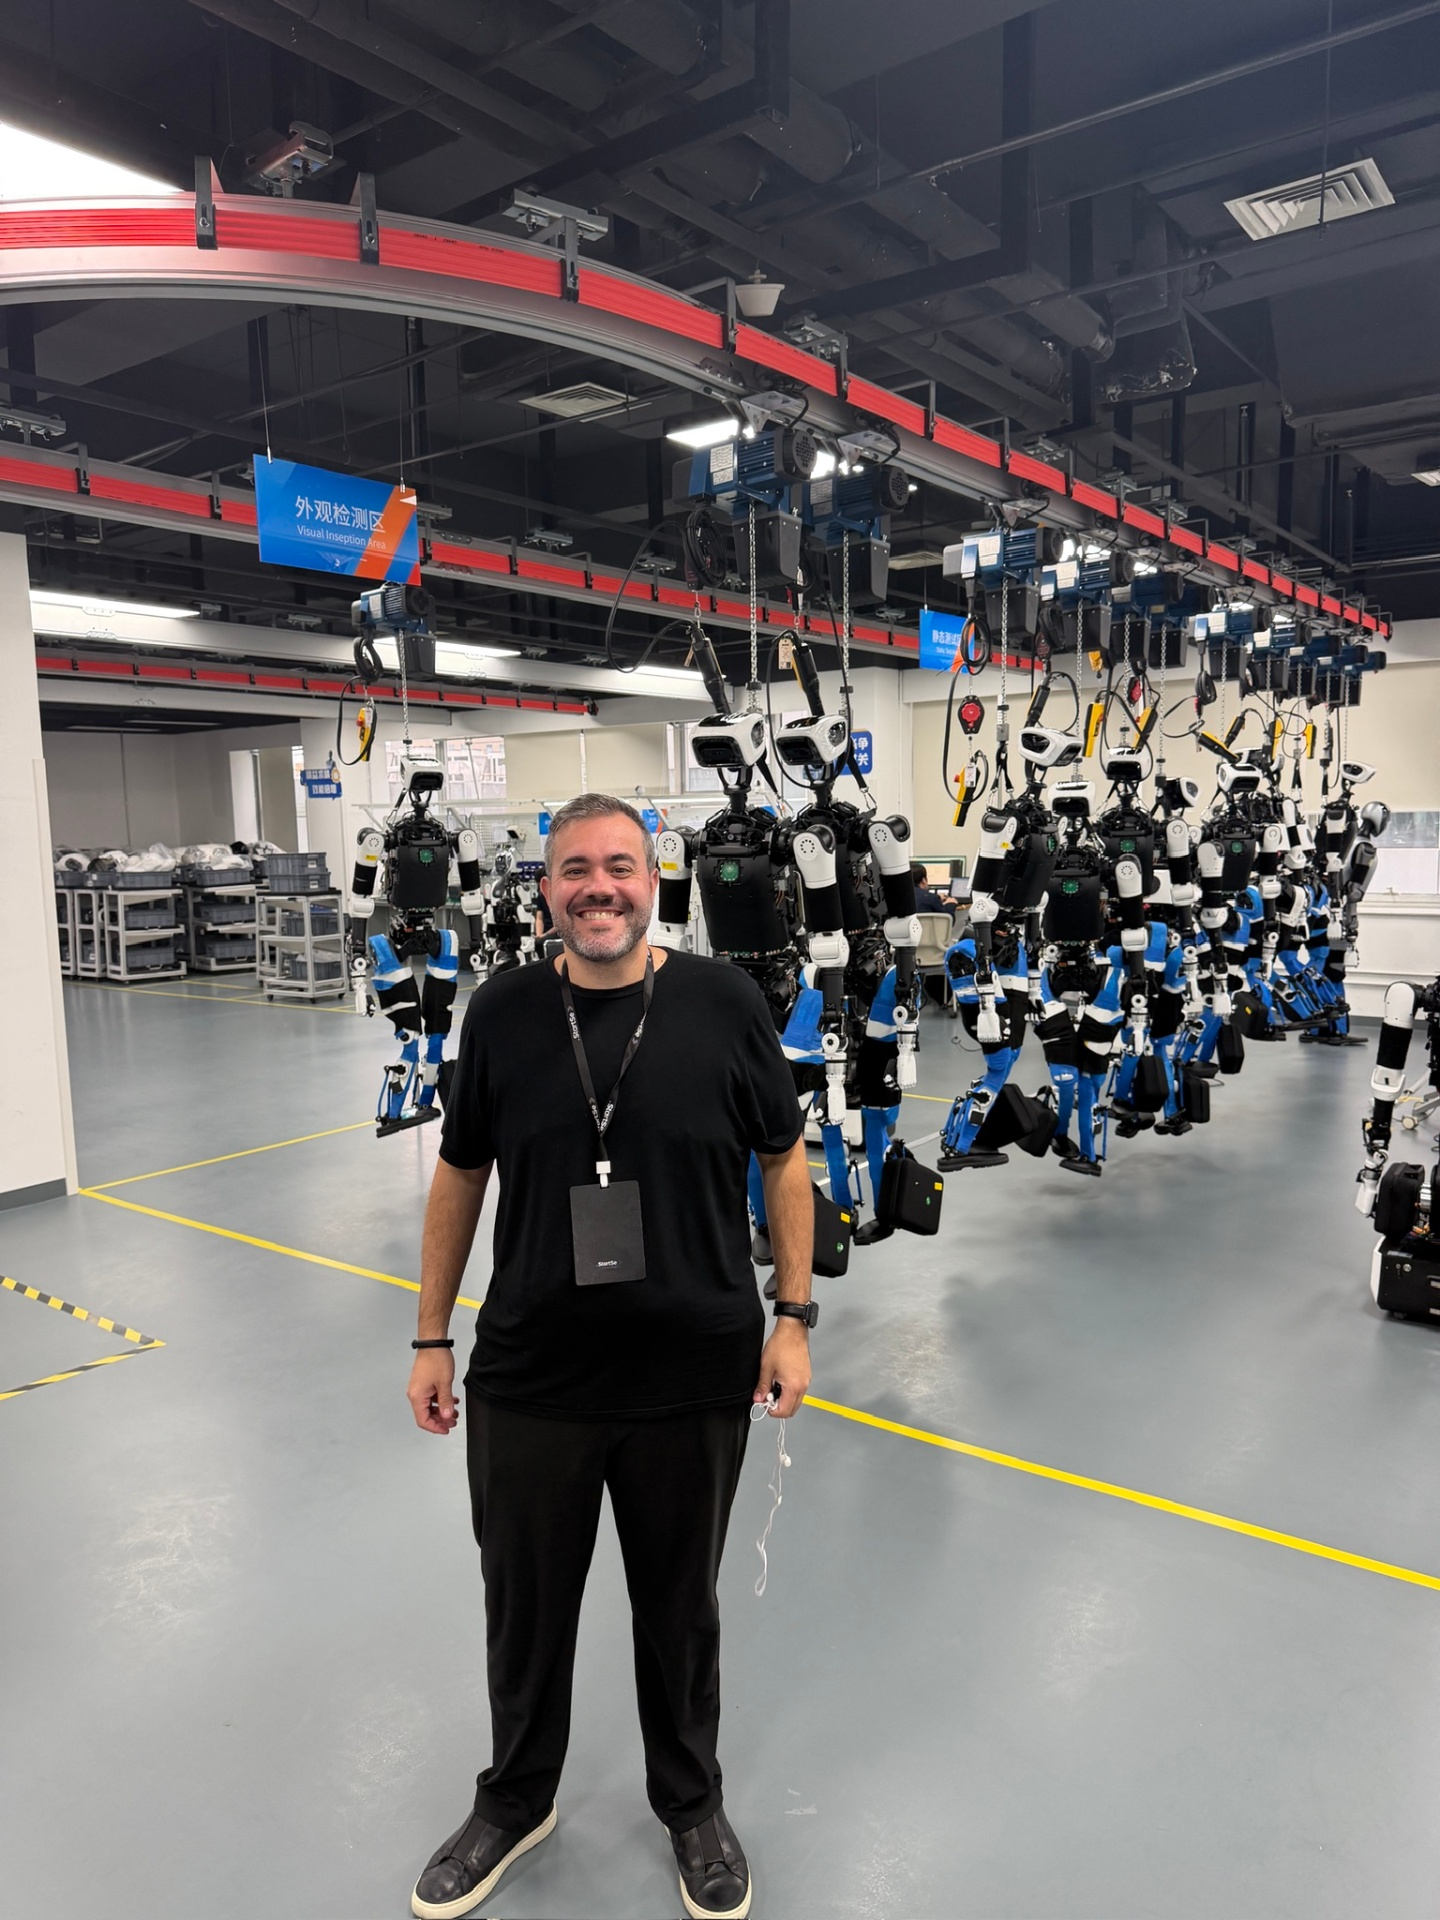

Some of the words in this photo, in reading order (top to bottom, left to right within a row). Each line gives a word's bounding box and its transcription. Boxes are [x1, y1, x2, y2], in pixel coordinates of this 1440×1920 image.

[295, 495, 386, 533] 外观检测区
[297, 525, 325, 539] Visual
[326, 530, 366, 546] Inseption
[367, 538, 386, 549] Area
